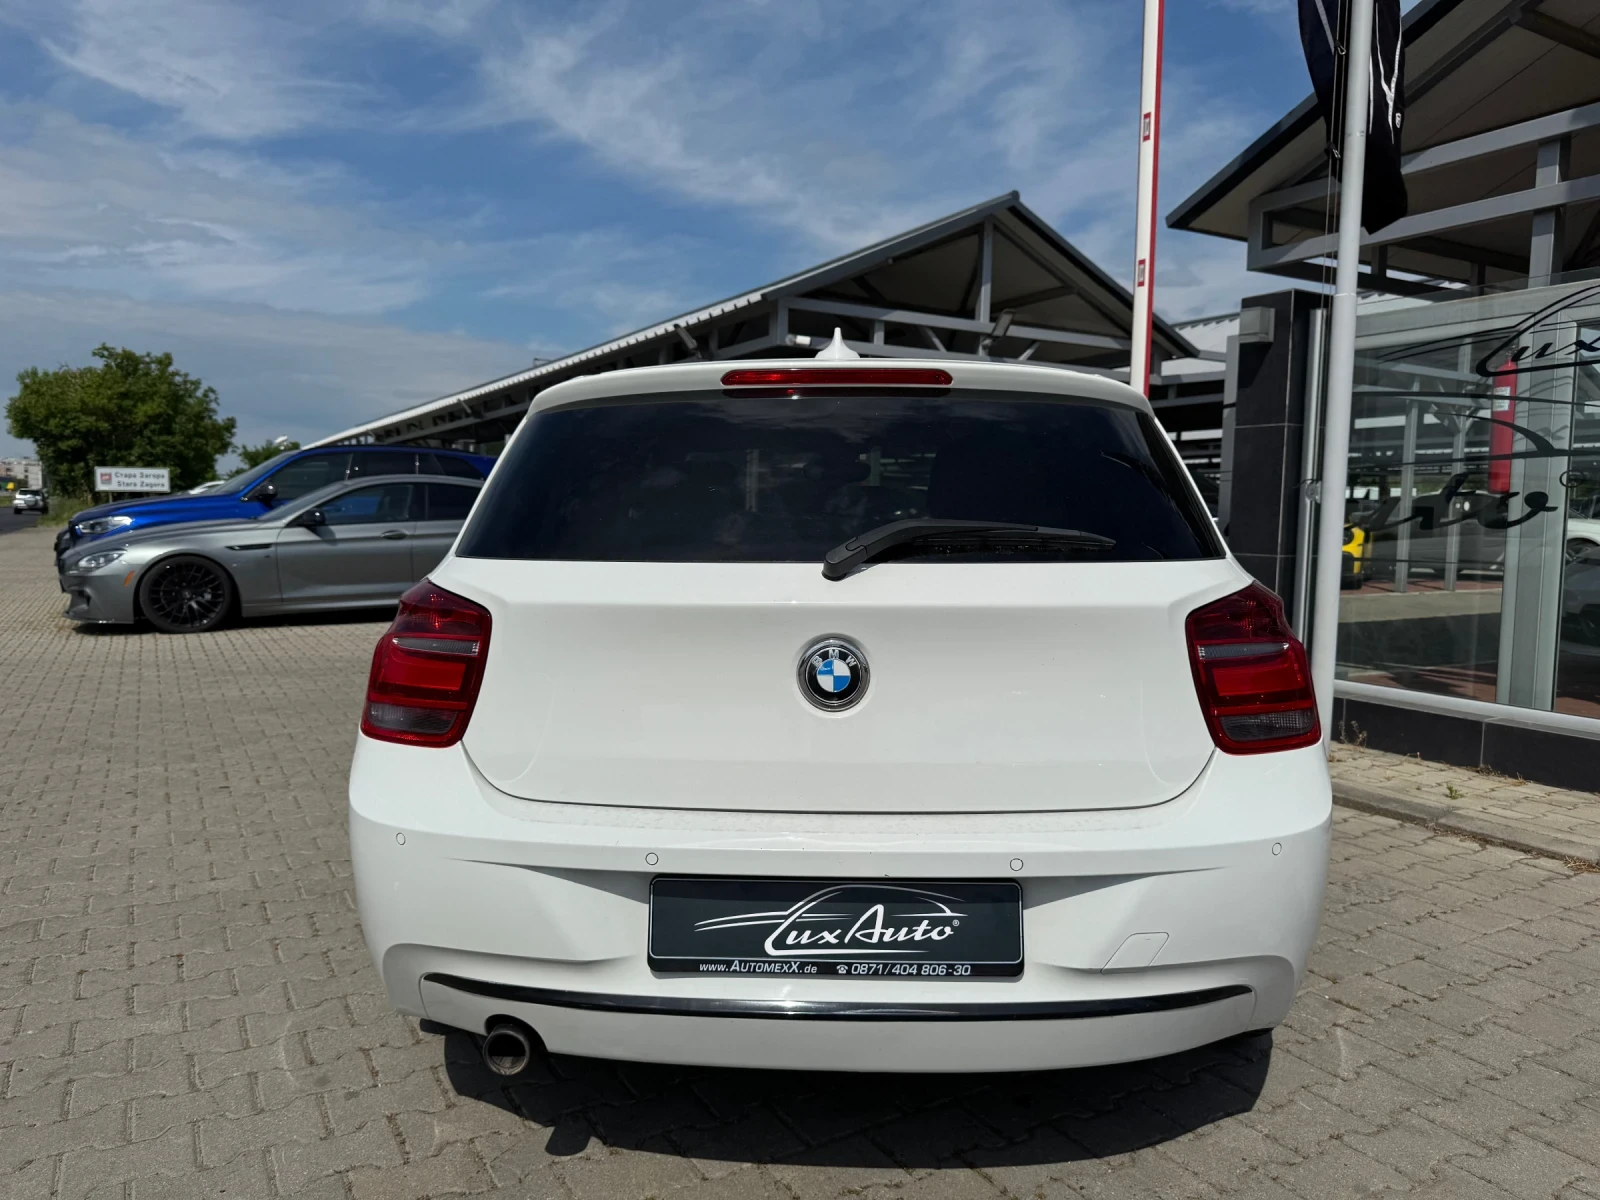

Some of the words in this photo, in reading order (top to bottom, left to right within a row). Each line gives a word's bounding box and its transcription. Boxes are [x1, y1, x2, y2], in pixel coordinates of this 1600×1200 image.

[114, 470, 137, 479] Стара
[140, 471, 165, 479] Загора
[117, 480, 137, 488] Stara
[140, 480, 165, 489] Zagora
[811, 648, 857, 669] BMW
[851, 963, 918, 976] 0871/404
[920, 964, 972, 977] 806-30
